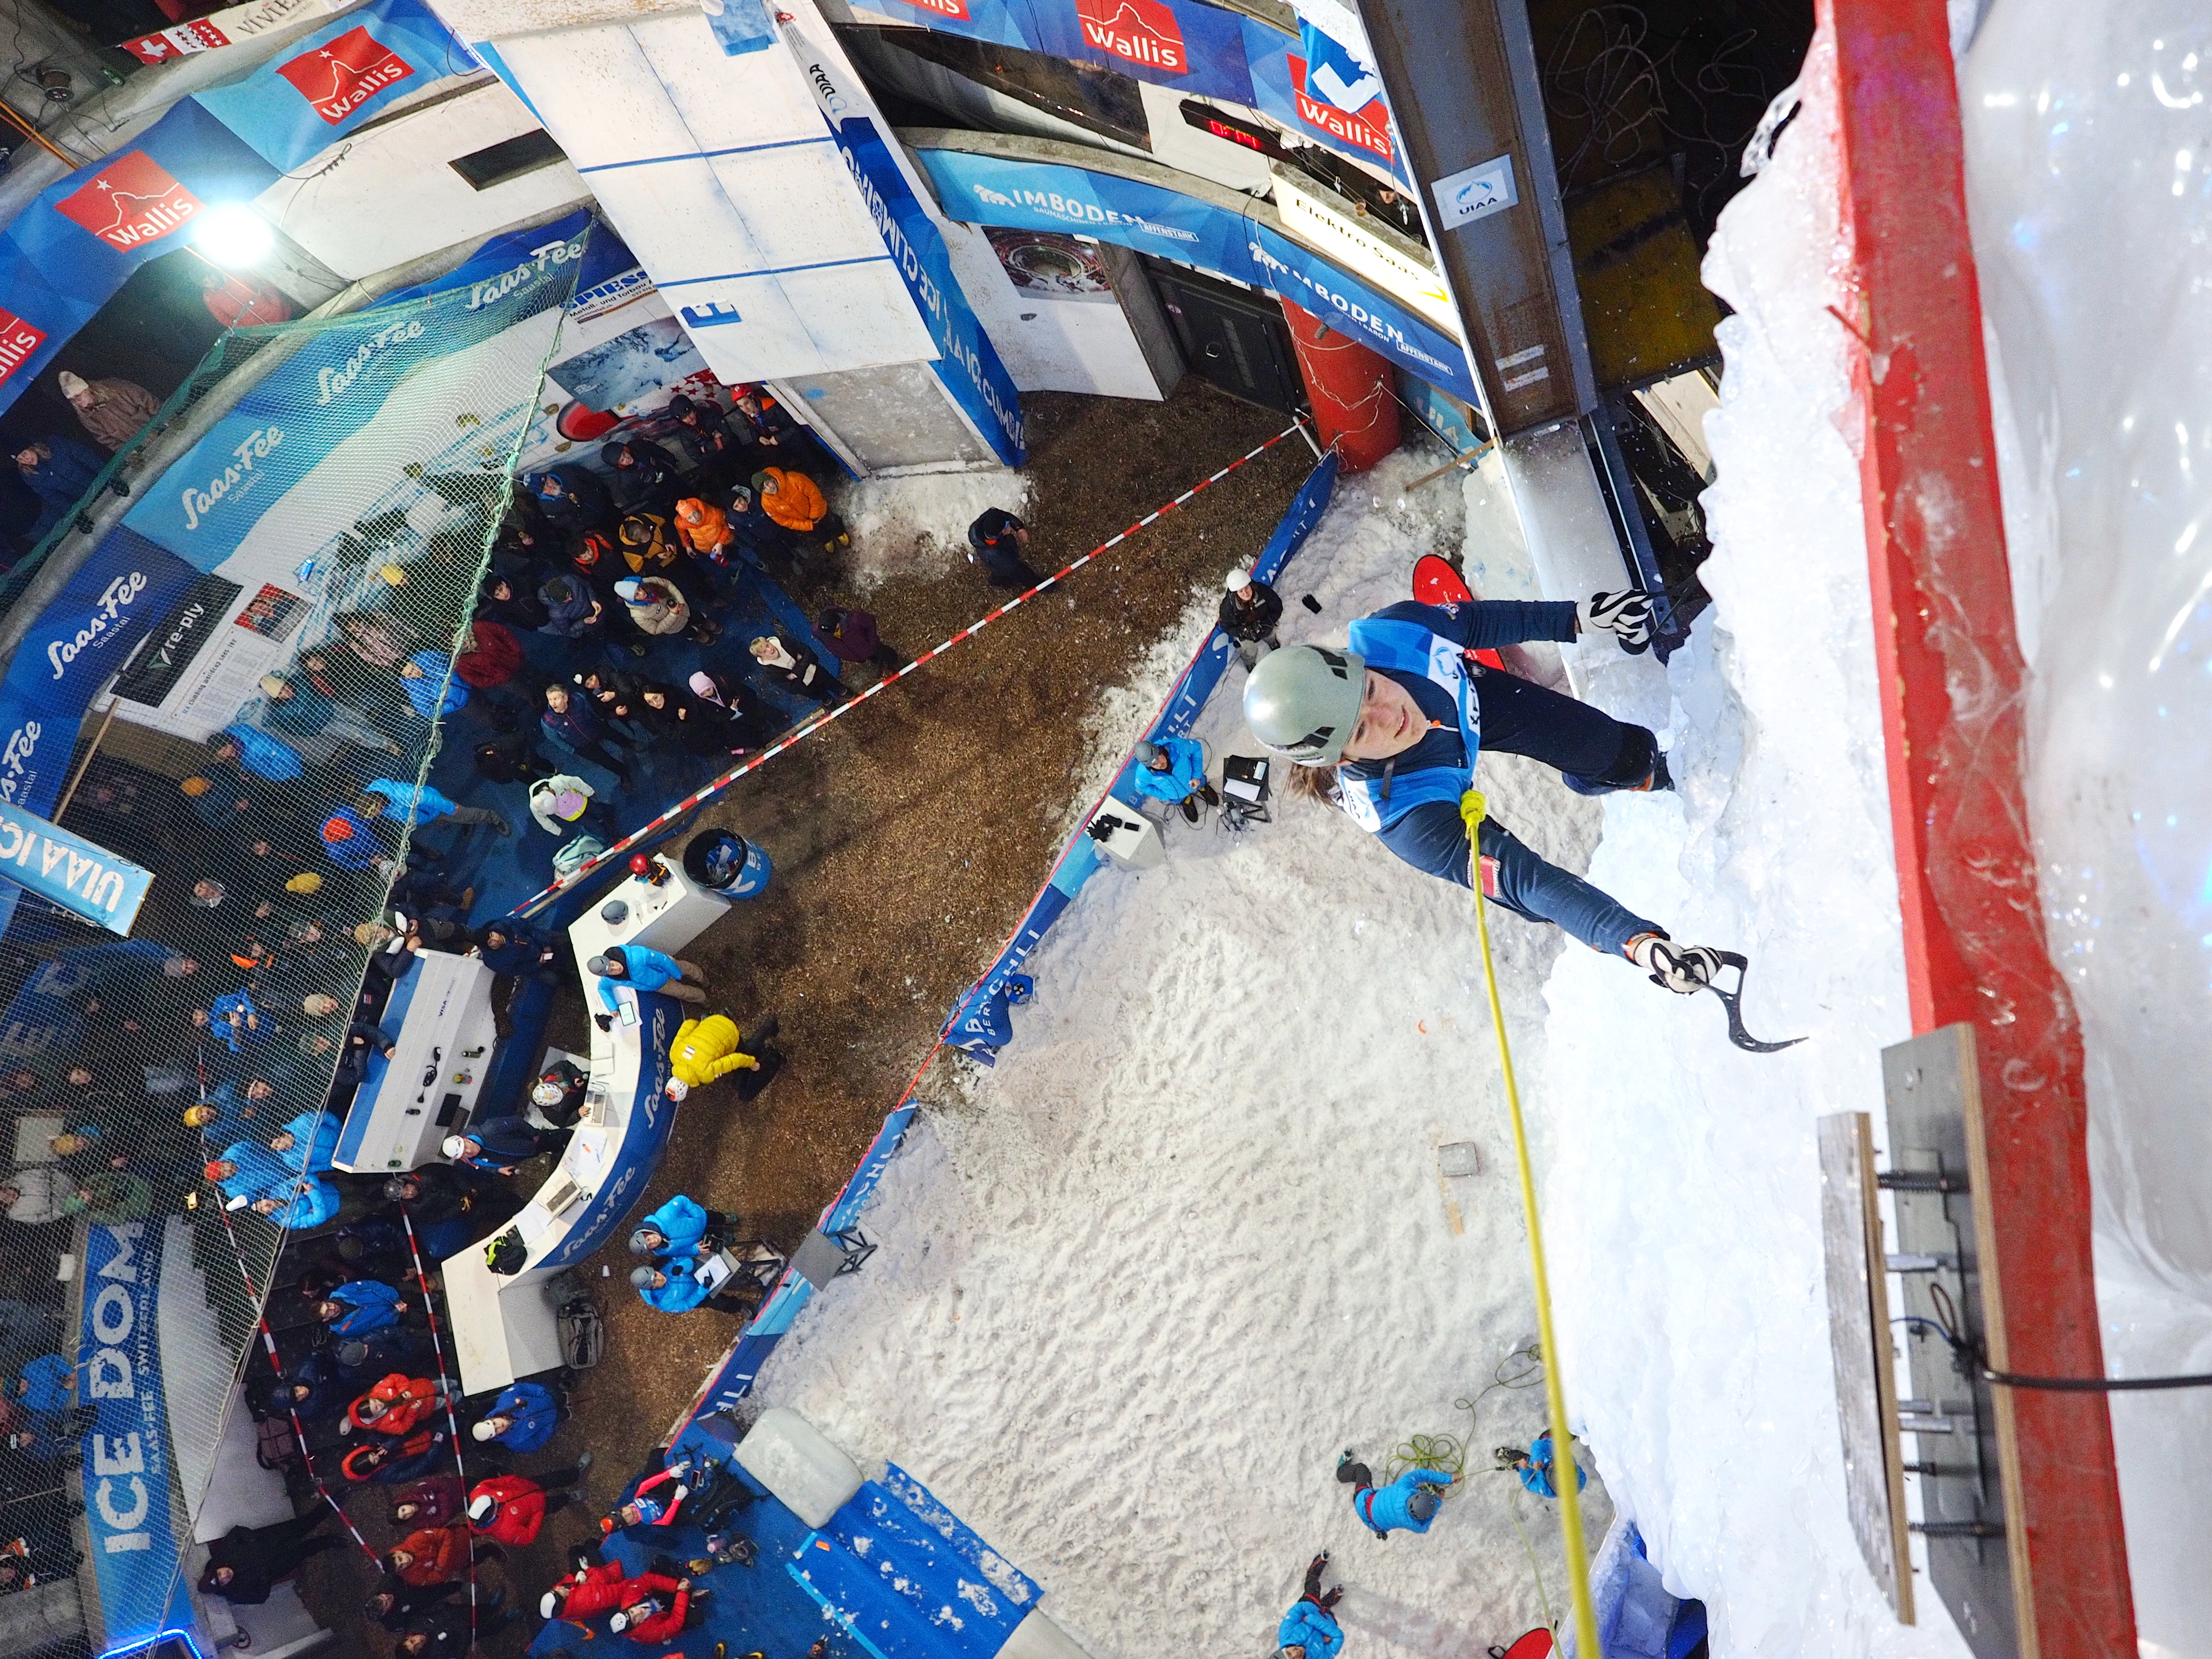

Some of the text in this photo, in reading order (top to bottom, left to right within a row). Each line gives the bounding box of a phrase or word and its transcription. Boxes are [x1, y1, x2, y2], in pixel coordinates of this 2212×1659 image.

[1085, 23, 1178, 67] Wallis
[321, 63, 403, 119] Wallis
[809, 63, 836, 96] UIAA
[1300, 98, 1388, 155] Wallis
[107, 196, 194, 246] Wallis
[1459, 196, 1498, 216] UIAA
[1295, 198, 1420, 281] Elektro Saas
[600, 296, 617, 305] und
[0, 331, 36, 378] llis
[164, 602, 204, 650] re-ply
[0, 817, 125, 913] UIAA IC
[90, 1221, 151, 1554] ICE DOM
